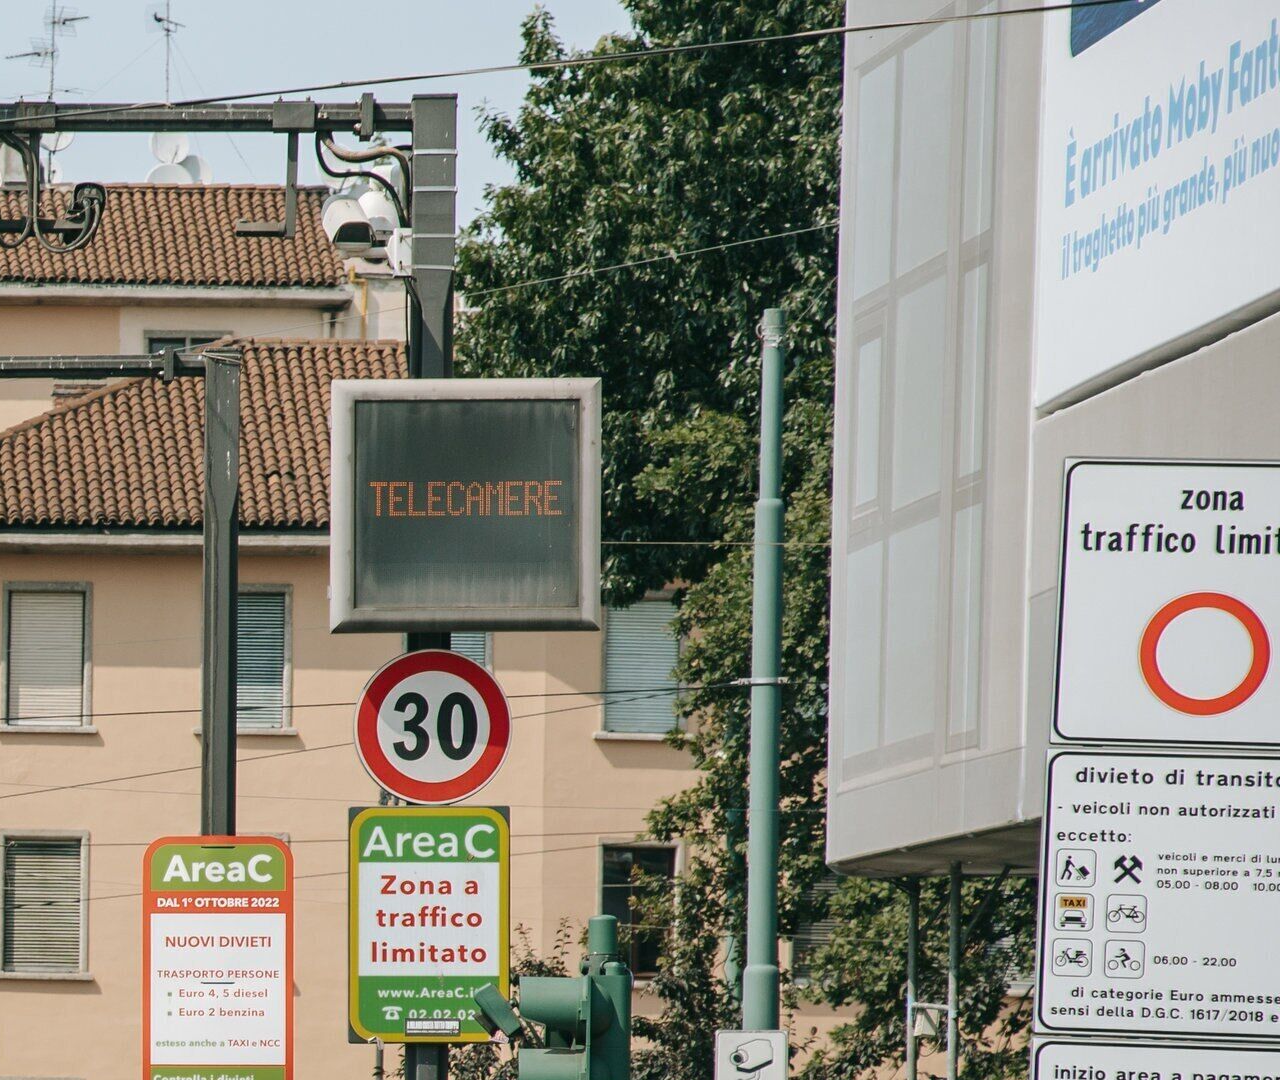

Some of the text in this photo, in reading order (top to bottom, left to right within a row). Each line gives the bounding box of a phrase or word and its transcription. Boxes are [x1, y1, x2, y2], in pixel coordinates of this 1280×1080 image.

[1065, 18, 1280, 208] È arrivato Moby Fant
[1061, 233, 1071, 280] il
[1073, 202, 1135, 274] traghetto
[1137, 183, 1161, 249] più
[1162, 156, 1220, 235] grande,
[1222, 134, 1248, 205] più
[367, 480, 563, 517] TELECAMERE
[1181, 489, 1244, 511] zona
[1081, 522, 1196, 553] traffico
[392, 691, 478, 761] 30
[1075, 767, 1154, 785] divieto
[1165, 769, 1185, 785] di
[1072, 801, 1131, 816] veicoli
[1139, 804, 1170, 816] non
[1178, 804, 1276, 819] autorizzati
[1057, 829, 1132, 843] eccetto:
[1158, 852, 1197, 862] veicoli
[1213, 854, 1246, 864] merci
[1251, 854, 1262, 864] di
[163, 854, 273, 883] AreaC
[1157, 866, 1178, 875] non
[1183, 867, 1239, 878] superiore
[1243, 869, 1250, 878] a
[380, 875, 479, 895] Zona a
[1156, 879, 1191, 890] 05.00
[1204, 881, 1239, 891] 08.00
[157, 898, 180, 907] DAL
[194, 897, 249, 908] OTTOBRE
[251, 897, 280, 908] 2022
[1063, 898, 1087, 908] TAXI
[376, 905, 483, 928] traffico
[165, 935, 272, 948] NUOVI DIVIETI
[371, 941, 488, 963] limitato
[1153, 955, 1188, 965] 06.00
[1202, 957, 1237, 967] 22.00
[157, 970, 280, 979] TRASPORTO PERSONE
[178, 988, 268, 999] Euro 4, 5 diesel
[1071, 987, 1084, 998] di
[1091, 989, 1163, 1002] categorie
[1170, 990, 1204, 1001] Euro
[178, 1007, 265, 1017] Euro 2 benzina
[1051, 1005, 1279, 1023] sensi della D.G.C. 1617/2018 e
[155, 1039, 186, 1048] esteso
[189, 1039, 217, 1048] anche
[227, 1039, 250, 1048] TAXI
[260, 1039, 281, 1048] NCC
[1054, 1065, 1106, 1080] inizio
